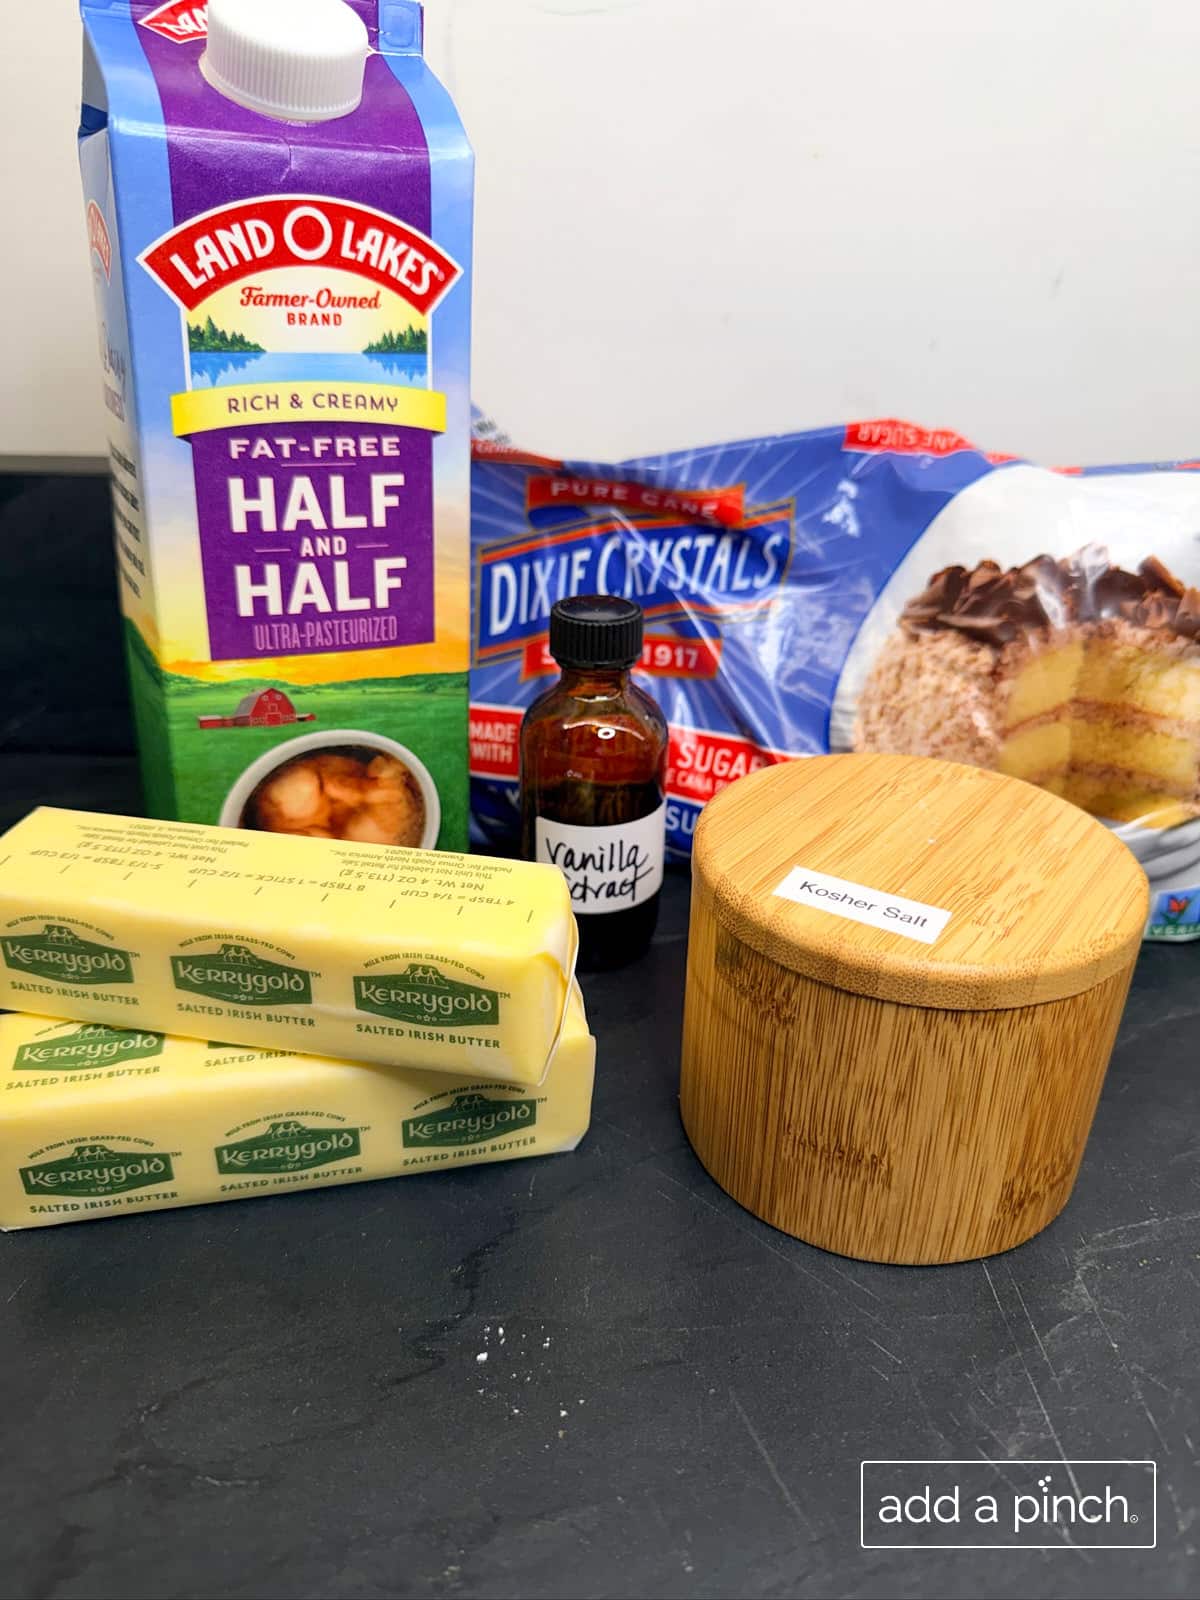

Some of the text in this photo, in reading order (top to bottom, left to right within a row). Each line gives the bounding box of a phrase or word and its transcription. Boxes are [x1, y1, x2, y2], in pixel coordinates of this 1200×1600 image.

[169, 218, 275, 290] LAND
[283, 206, 332, 260] O
[240, 286, 381, 308] Farmer-Owned
[287, 312, 342, 326] BRAND
[227, 393, 399, 413] RICH & CREAMY
[229, 437, 401, 459] FAT-FREE
[228, 473, 405, 533] HALF
[551, 482, 719, 519] PURE CANE
[301, 536, 347, 557] AND
[234, 556, 407, 617] HALF
[490, 532, 782, 637] DIXIE CRYSTALS
[254, 616, 397, 651] ULTRA-PASTEURIZED
[643, 644, 698, 669] 1917
[470, 721, 516, 742] MADE
[471, 742, 513, 763] WITH
[188, 868, 217, 876] CUP
[400, 889, 429, 897] CUP
[460, 882, 485, 891] Net
[469, 896, 501, 905] TBSP
[799, 881, 928, 928] Kosher Salt
[381, 953, 401, 963] FROM
[10, 981, 140, 1006] SALTED IRISH BUTTER
[176, 1002, 316, 1027] SALTED IRISH BUTTER
[356, 1023, 501, 1049] SALTED IRISH BUTTER
[204, 1054, 256, 1067] SALTED
[5, 1066, 161, 1090] SALTED IRISH BUTTER
[403, 1136, 536, 1167] SALTED IRISH BUTTER
[220, 1166, 363, 1192] SALTED IRISH BUTTER
[29, 1191, 179, 1214] SALTED IRISH BUTTER
